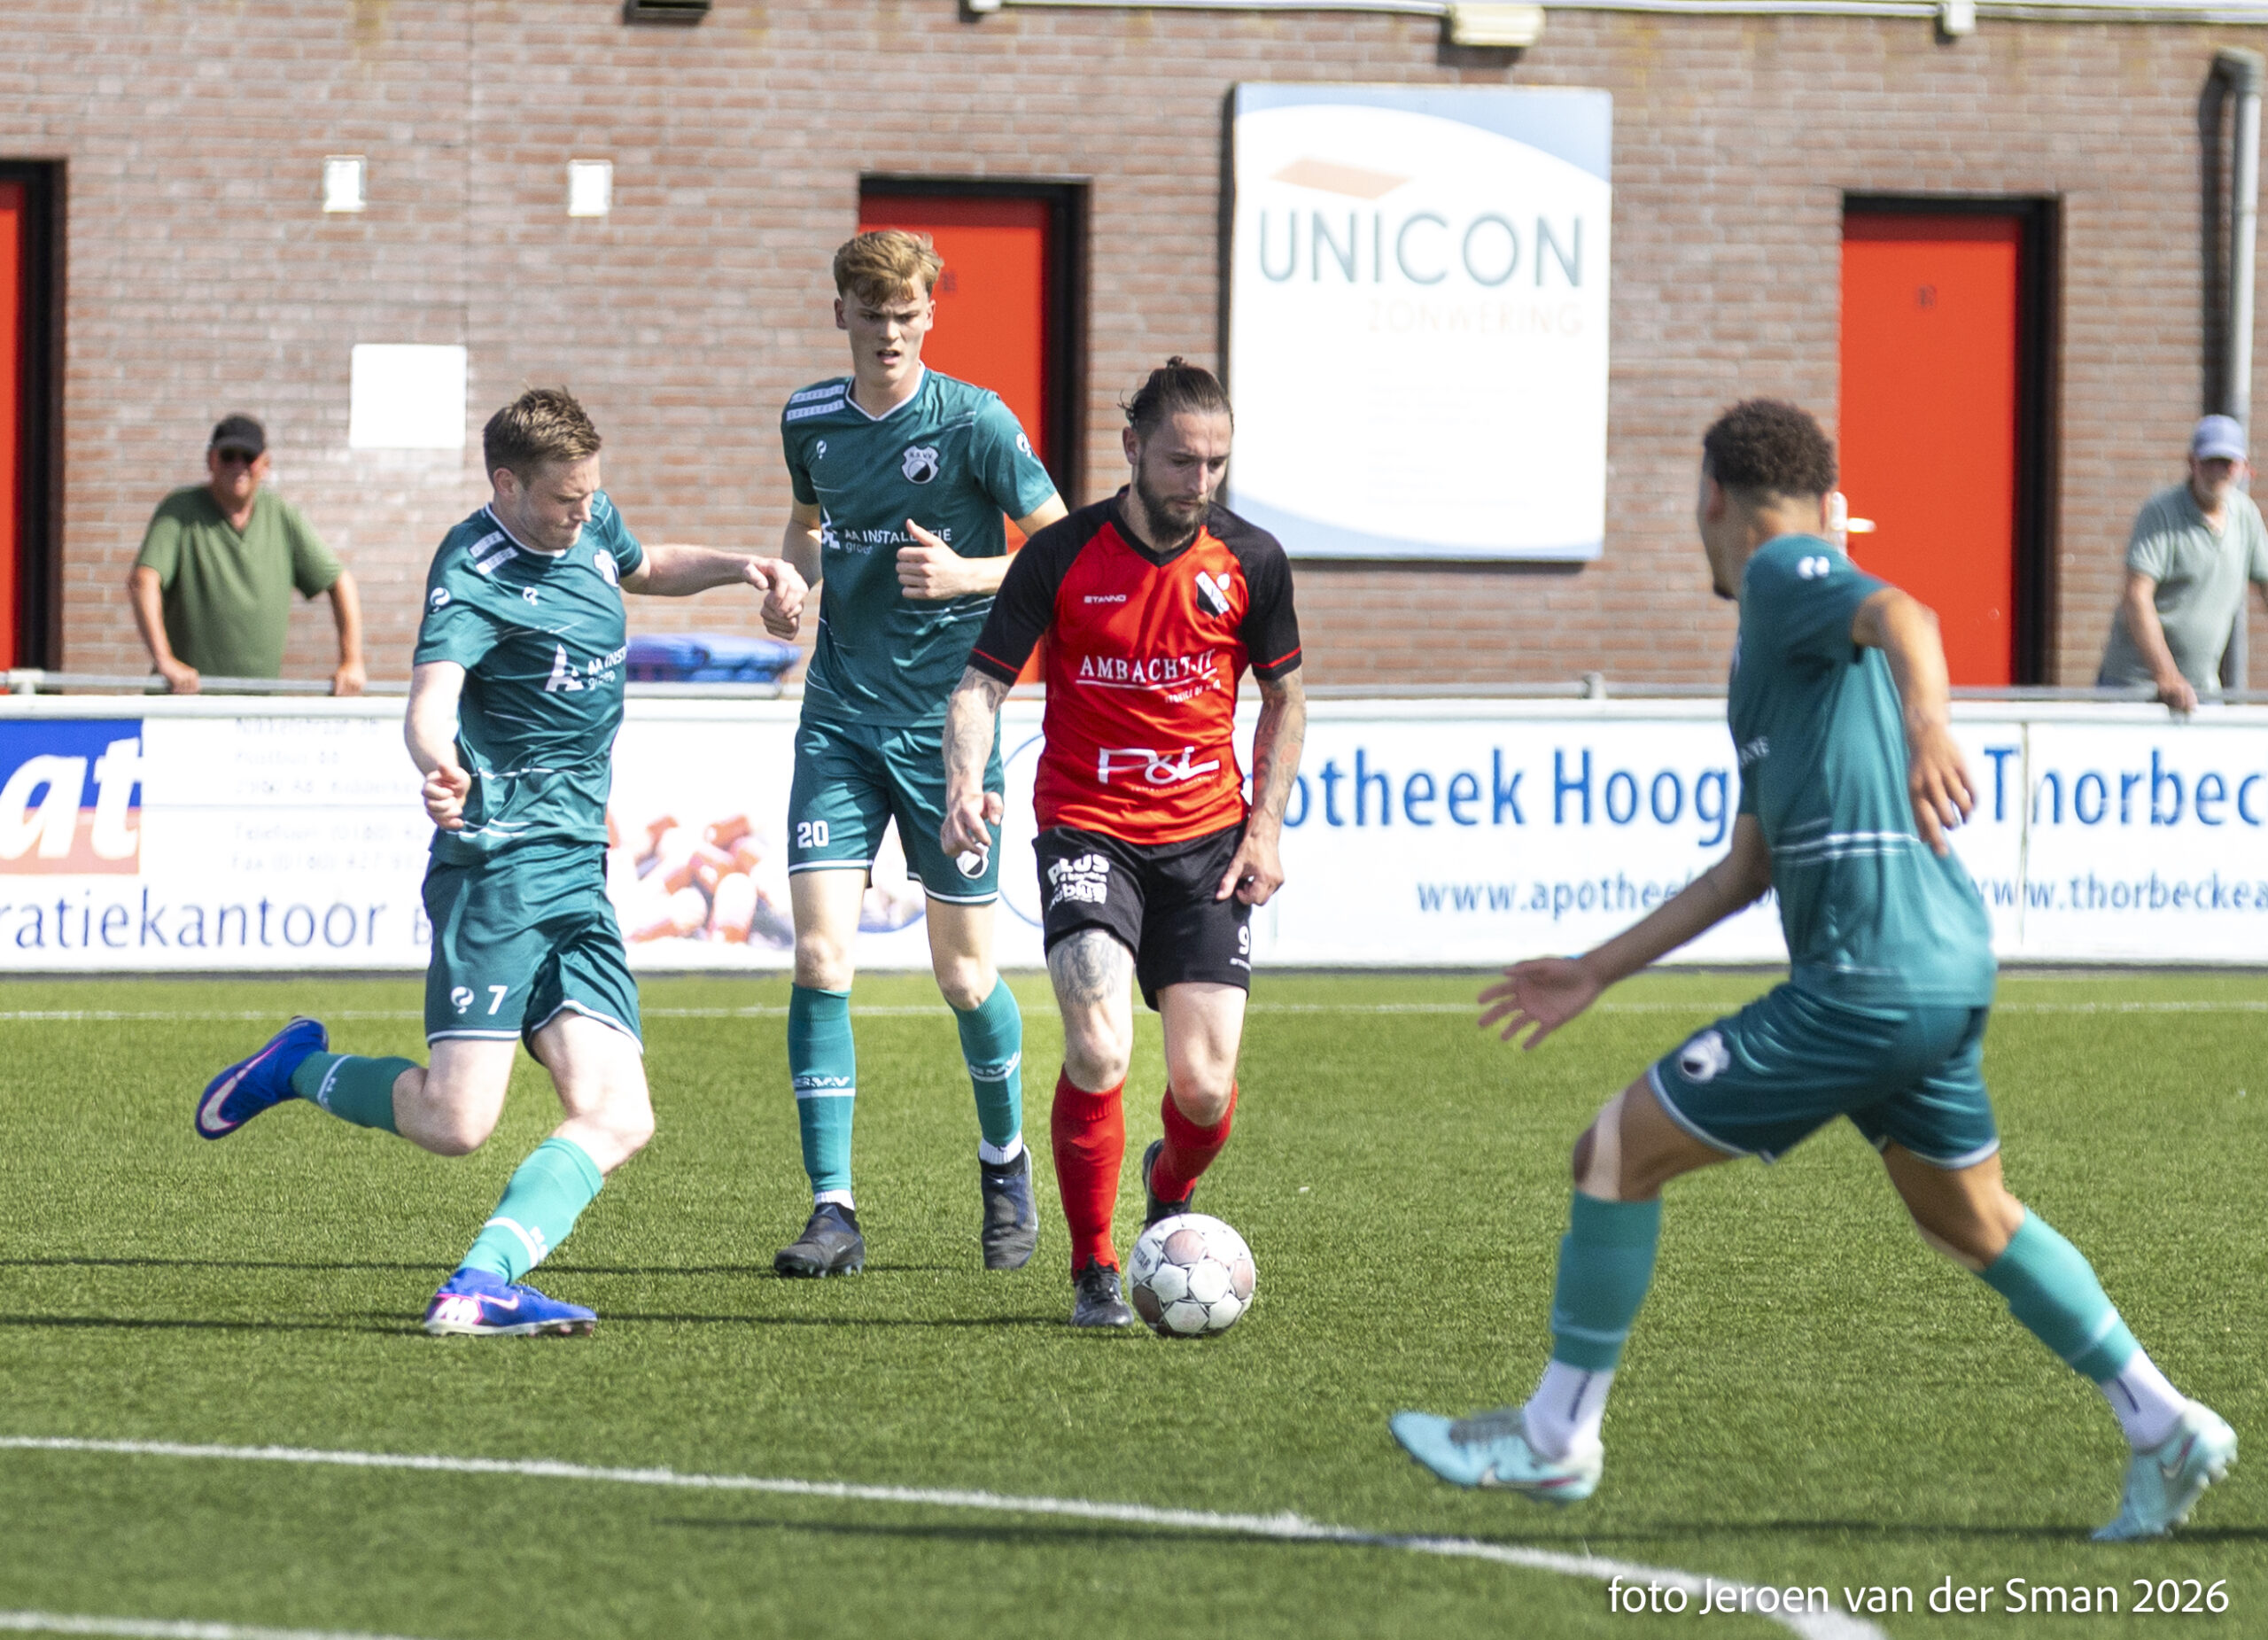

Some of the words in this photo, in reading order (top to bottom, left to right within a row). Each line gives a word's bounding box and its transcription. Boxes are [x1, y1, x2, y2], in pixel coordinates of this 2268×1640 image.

[1259, 209, 1583, 288] UNICON
[1367, 299, 1585, 337] ZONWERING
[1554, 748, 1727, 847] Hoog
[797, 820, 828, 848] 20
[1048, 853, 1109, 886] PLUS
[1238, 926, 1250, 954] 9
[487, 985, 508, 1014] 7
